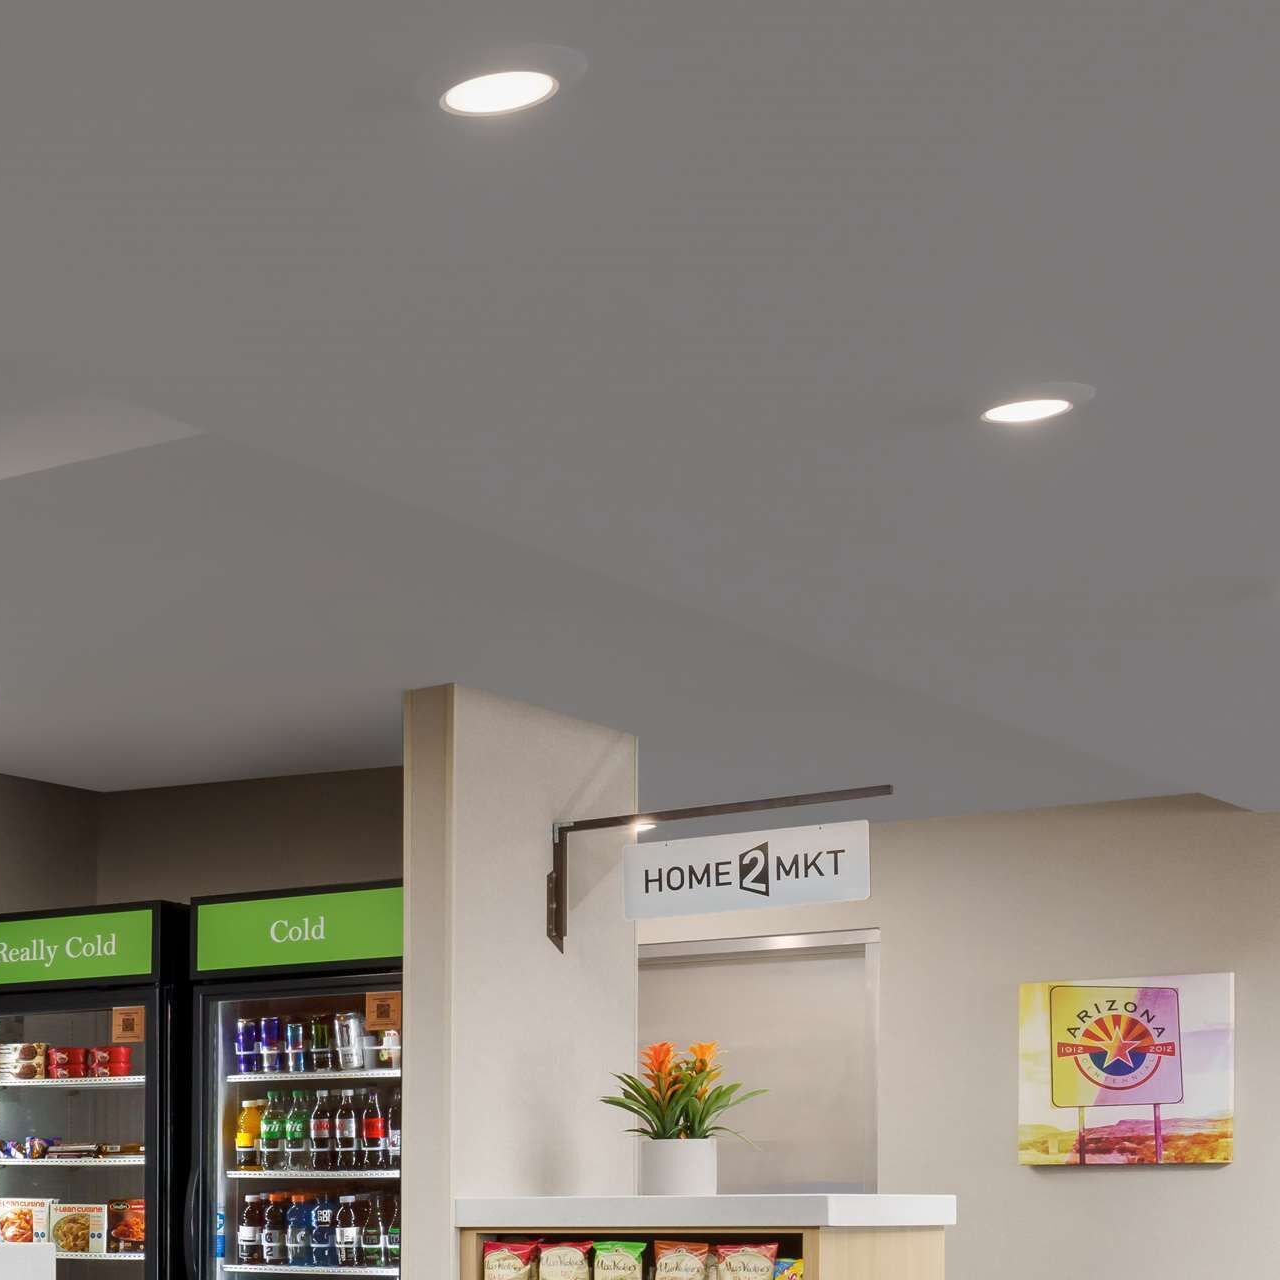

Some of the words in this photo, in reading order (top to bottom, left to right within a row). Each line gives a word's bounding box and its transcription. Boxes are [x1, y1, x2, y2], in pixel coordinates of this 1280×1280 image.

[270, 915, 326, 943] Cold
[65, 933, 117, 958] Cold
[1067, 999, 1166, 1038] ARIZONA
[1149, 1045, 1173, 1053] 2012
